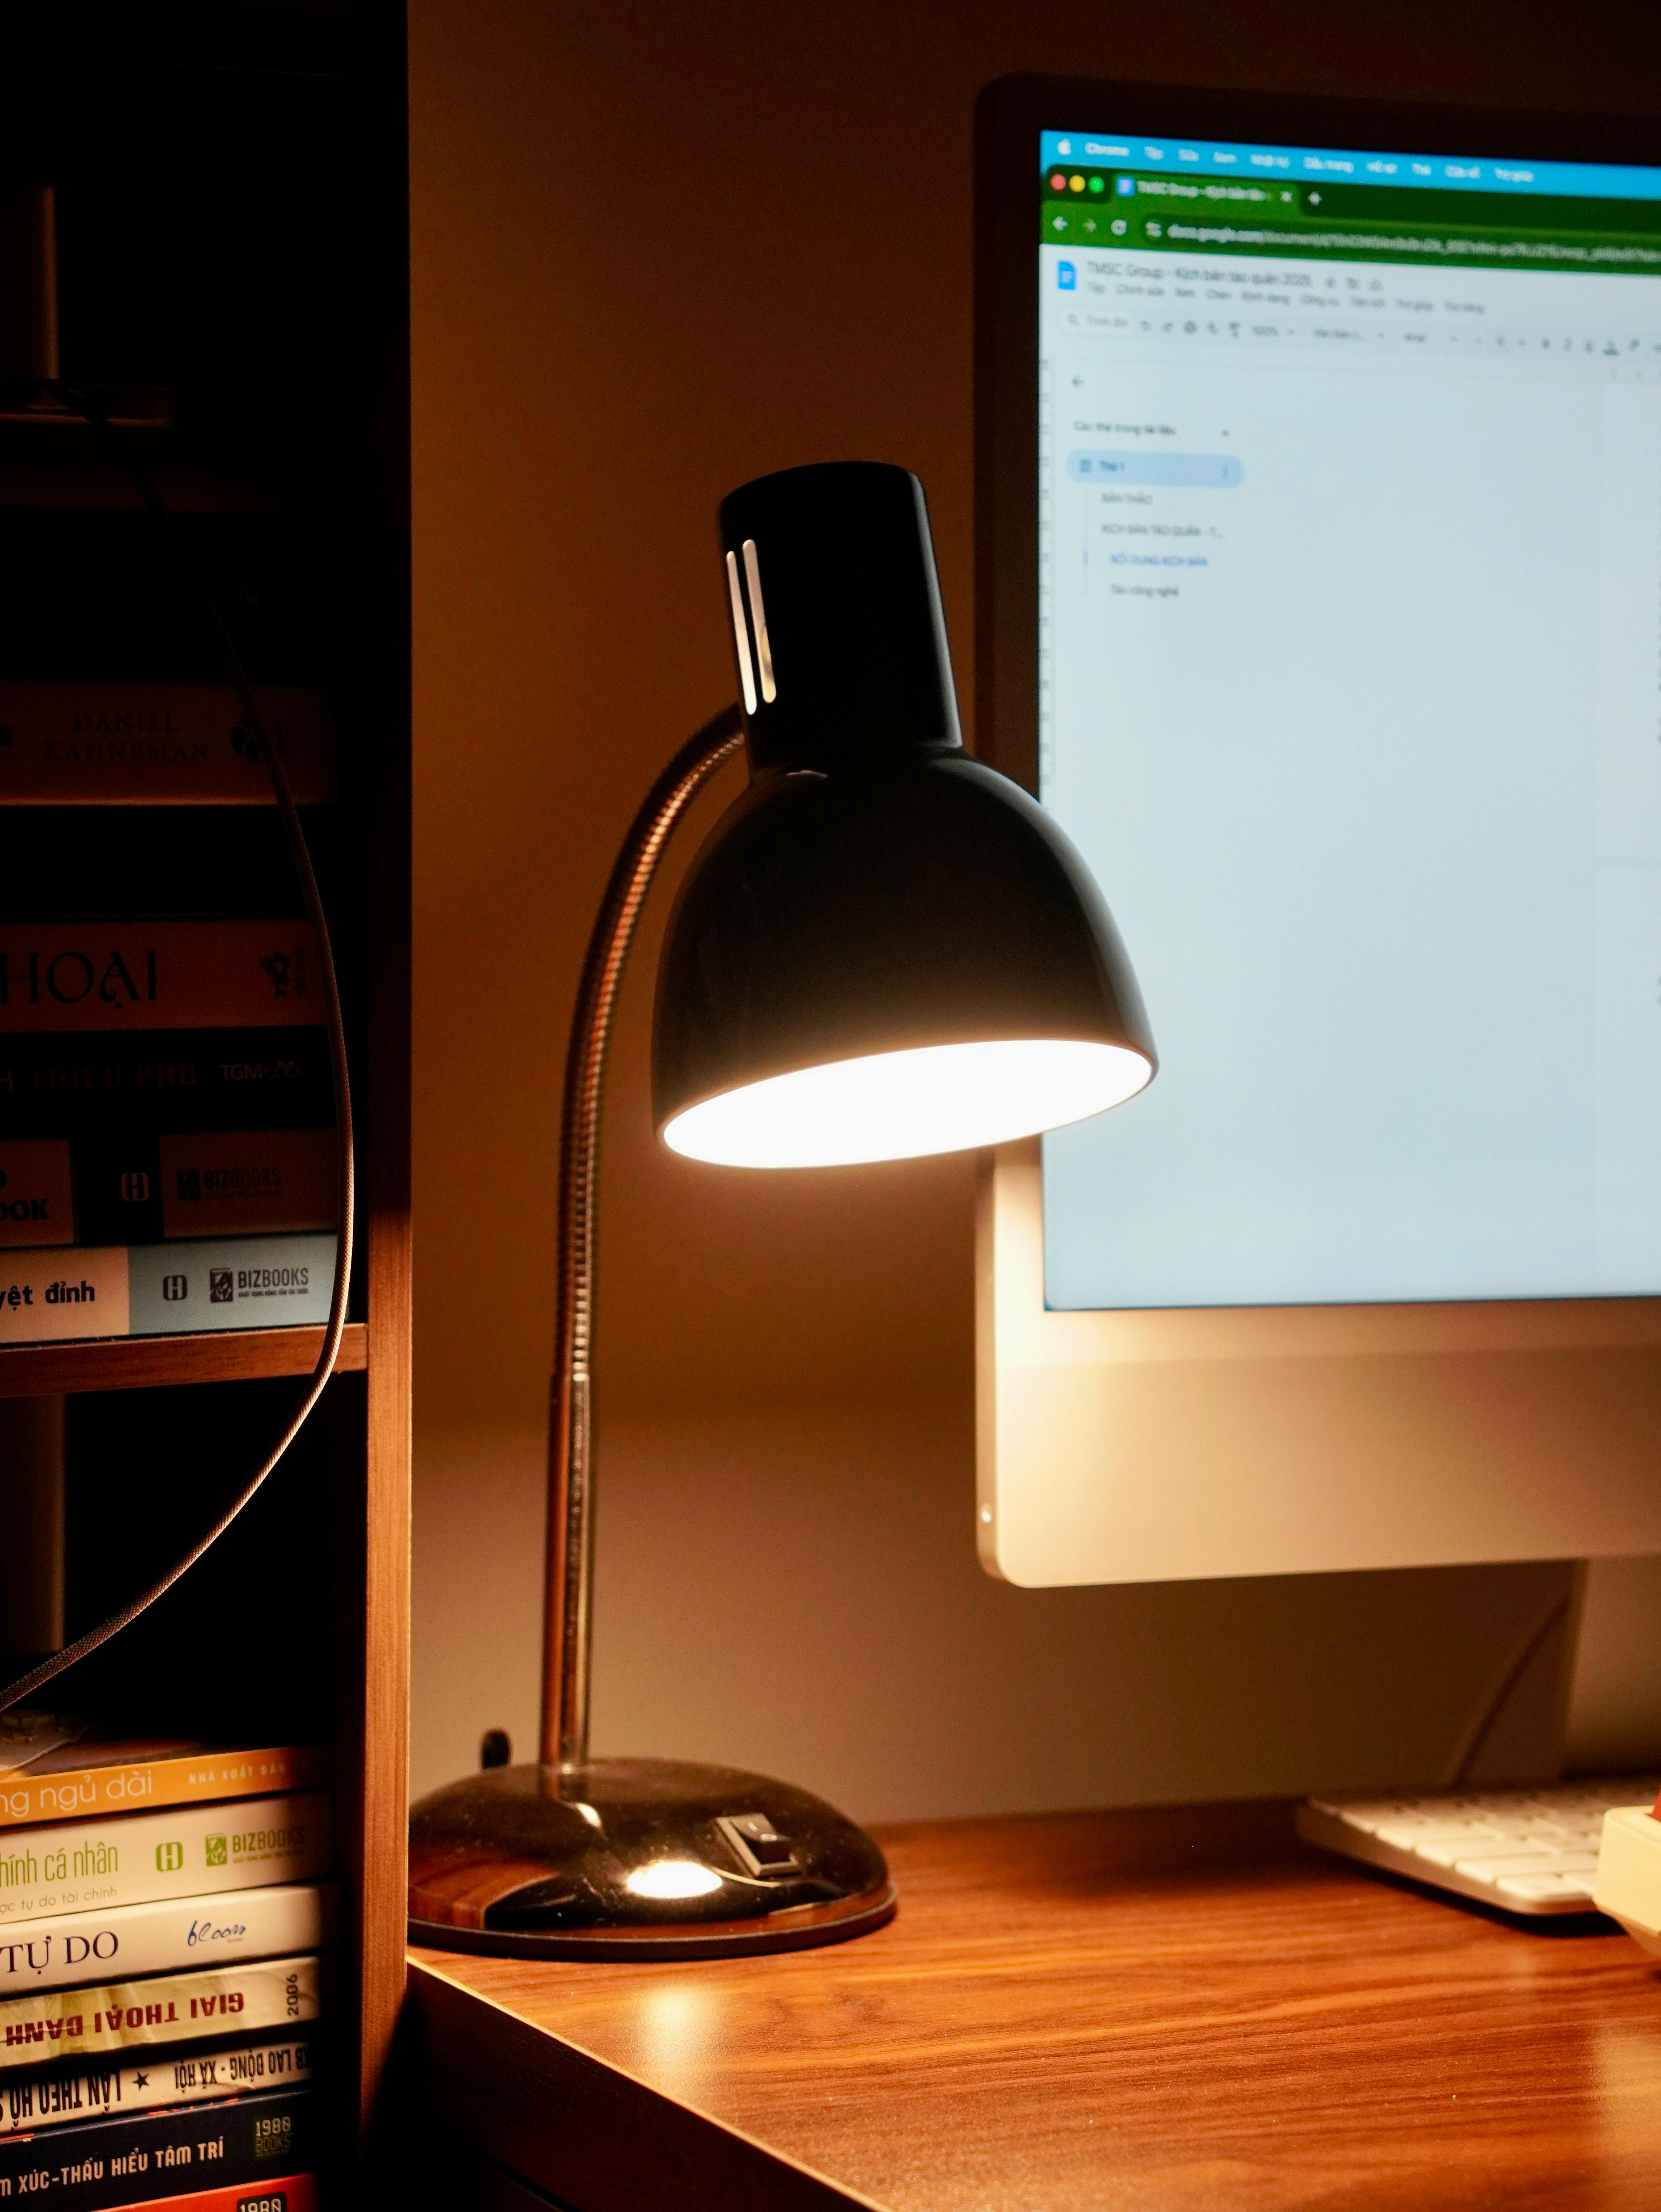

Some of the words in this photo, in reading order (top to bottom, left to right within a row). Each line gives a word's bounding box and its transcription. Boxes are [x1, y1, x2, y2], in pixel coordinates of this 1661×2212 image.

[75, 710, 179, 732] DANIEL
[46, 741, 209, 762] KAHNEMAN
[204, 1167, 282, 1190] BIZBOOKS
[238, 1267, 309, 1289] BIZBOOKS
[45, 1280, 95, 1304] đỉnh
[40, 1774, 96, 1811] ngủ
[106, 1770, 152, 1800] dài
[44, 1844, 67, 1882] cá
[74, 1840, 119, 1879] nhân
[39, 1895, 56, 1907] do
[84, 1886, 118, 1901] chính
[0, 1935, 52, 1975] TỰ
[64, 1931, 119, 1965] DO
[191, 1992, 245, 2019] GIAI
[286, 1973, 299, 2016] 2006
[6, 2014, 84, 2047] DANH
[94, 2001, 179, 2033] THOẠI
[269, 2047, 293, 2075] LAO
[255, 2116, 291, 2136] 1980
[111, 2147, 149, 2177] HIỂU
[198, 2136, 224, 2159] TRÍ
